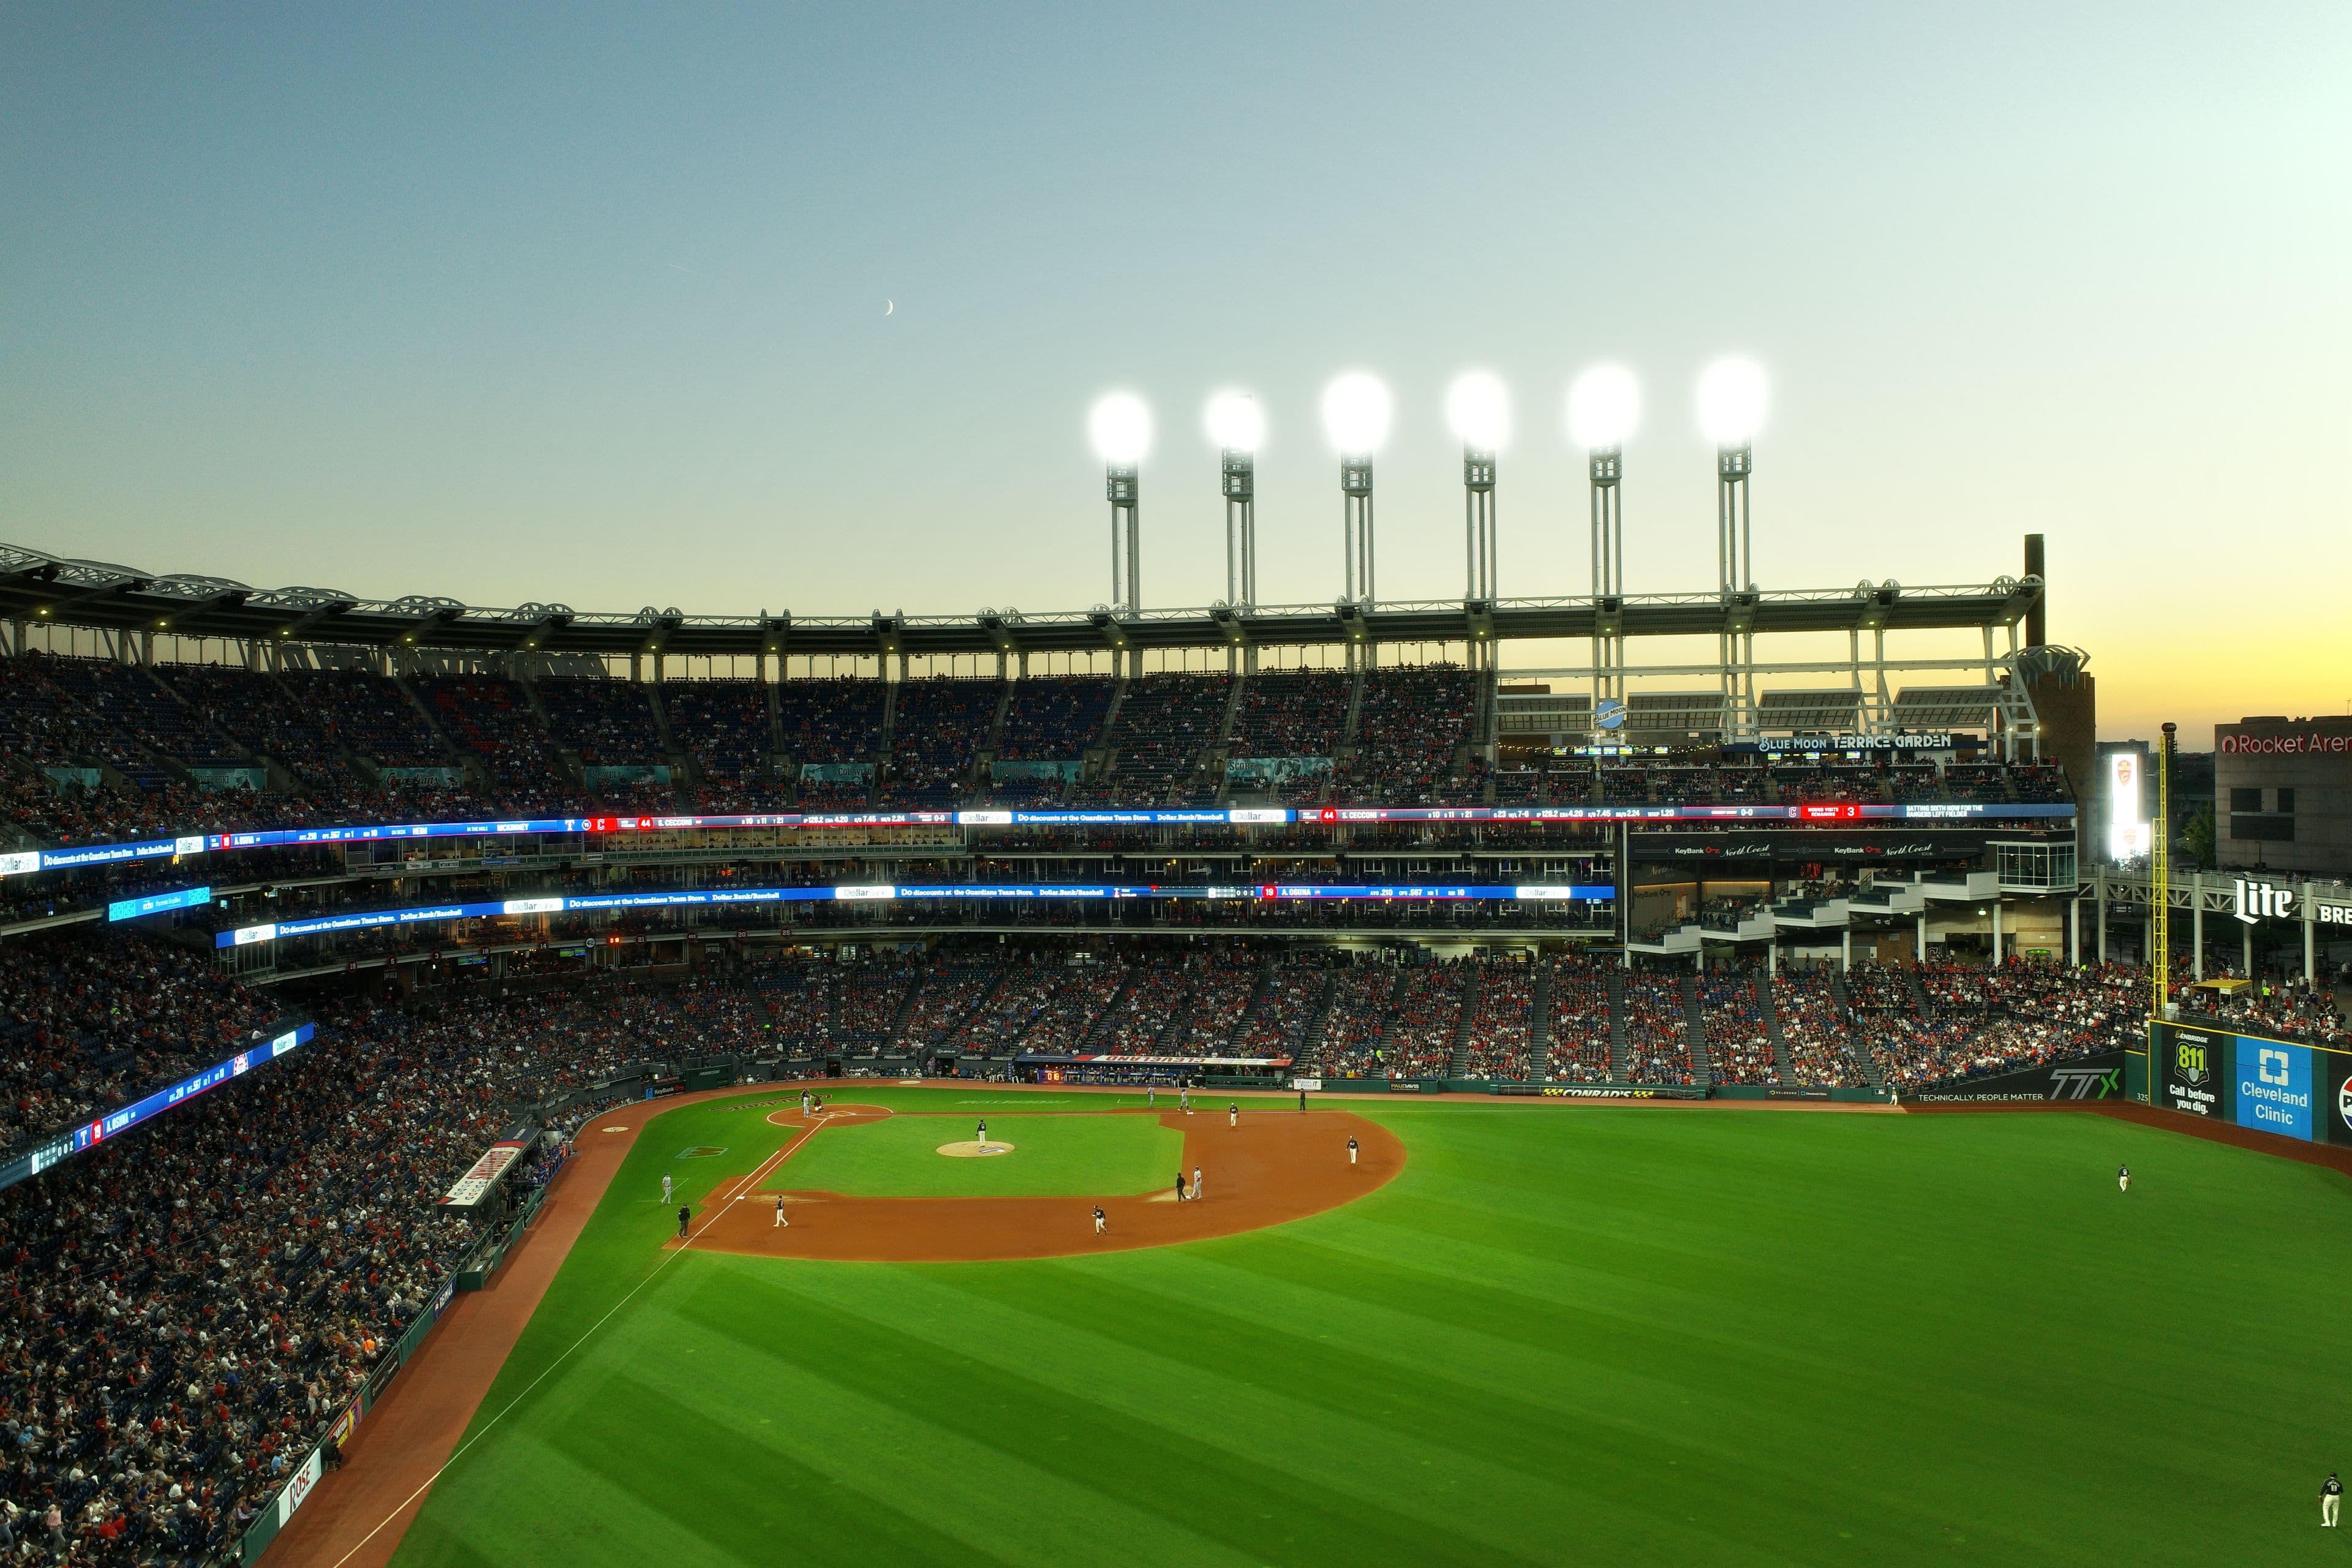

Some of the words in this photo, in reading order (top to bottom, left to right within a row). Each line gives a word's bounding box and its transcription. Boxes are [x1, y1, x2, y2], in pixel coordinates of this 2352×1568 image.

[1594, 712, 1610, 723] BLUE
[1610, 706, 1626, 717] MOON
[1759, 737, 1790, 752] BLUE
[1794, 738, 1826, 748] MOON
[1833, 736, 1891, 748] TERRACE
[1895, 735, 1951, 747] GARDEN
[2239, 734, 2304, 753] Rocket
[1847, 807, 1855, 816] 3
[2233, 879, 2294, 924] Lite
[280, 925, 289, 935] Do
[290, 923, 316, 933] discounts
[322, 921, 331, 930] the
[332, 918, 360, 928] Guardians
[361, 916, 377, 925] Team
[2180, 1033, 2209, 1044] ENBRIDGE
[2179, 1045, 2204, 1071] 811
[1562, 1089, 1632, 1098] CONRAD'S
[2136, 1093, 2149, 1102] 325
[2169, 1084, 2185, 1097] Call
[2188, 1088, 2215, 1102] before
[2242, 1081, 2308, 1107] Cleveland
[2176, 1099, 2192, 1110] you
[2193, 1101, 2209, 1115] dig.
[2255, 1104, 2293, 1125] Clinic
[94, 1125, 100, 1139] 19
[58, 1147, 62, 1156] 0
[64, 1144, 67, 1154] 0
[70, 1140, 74, 1152] 2
[290, 1461, 311, 1515] ROSE
